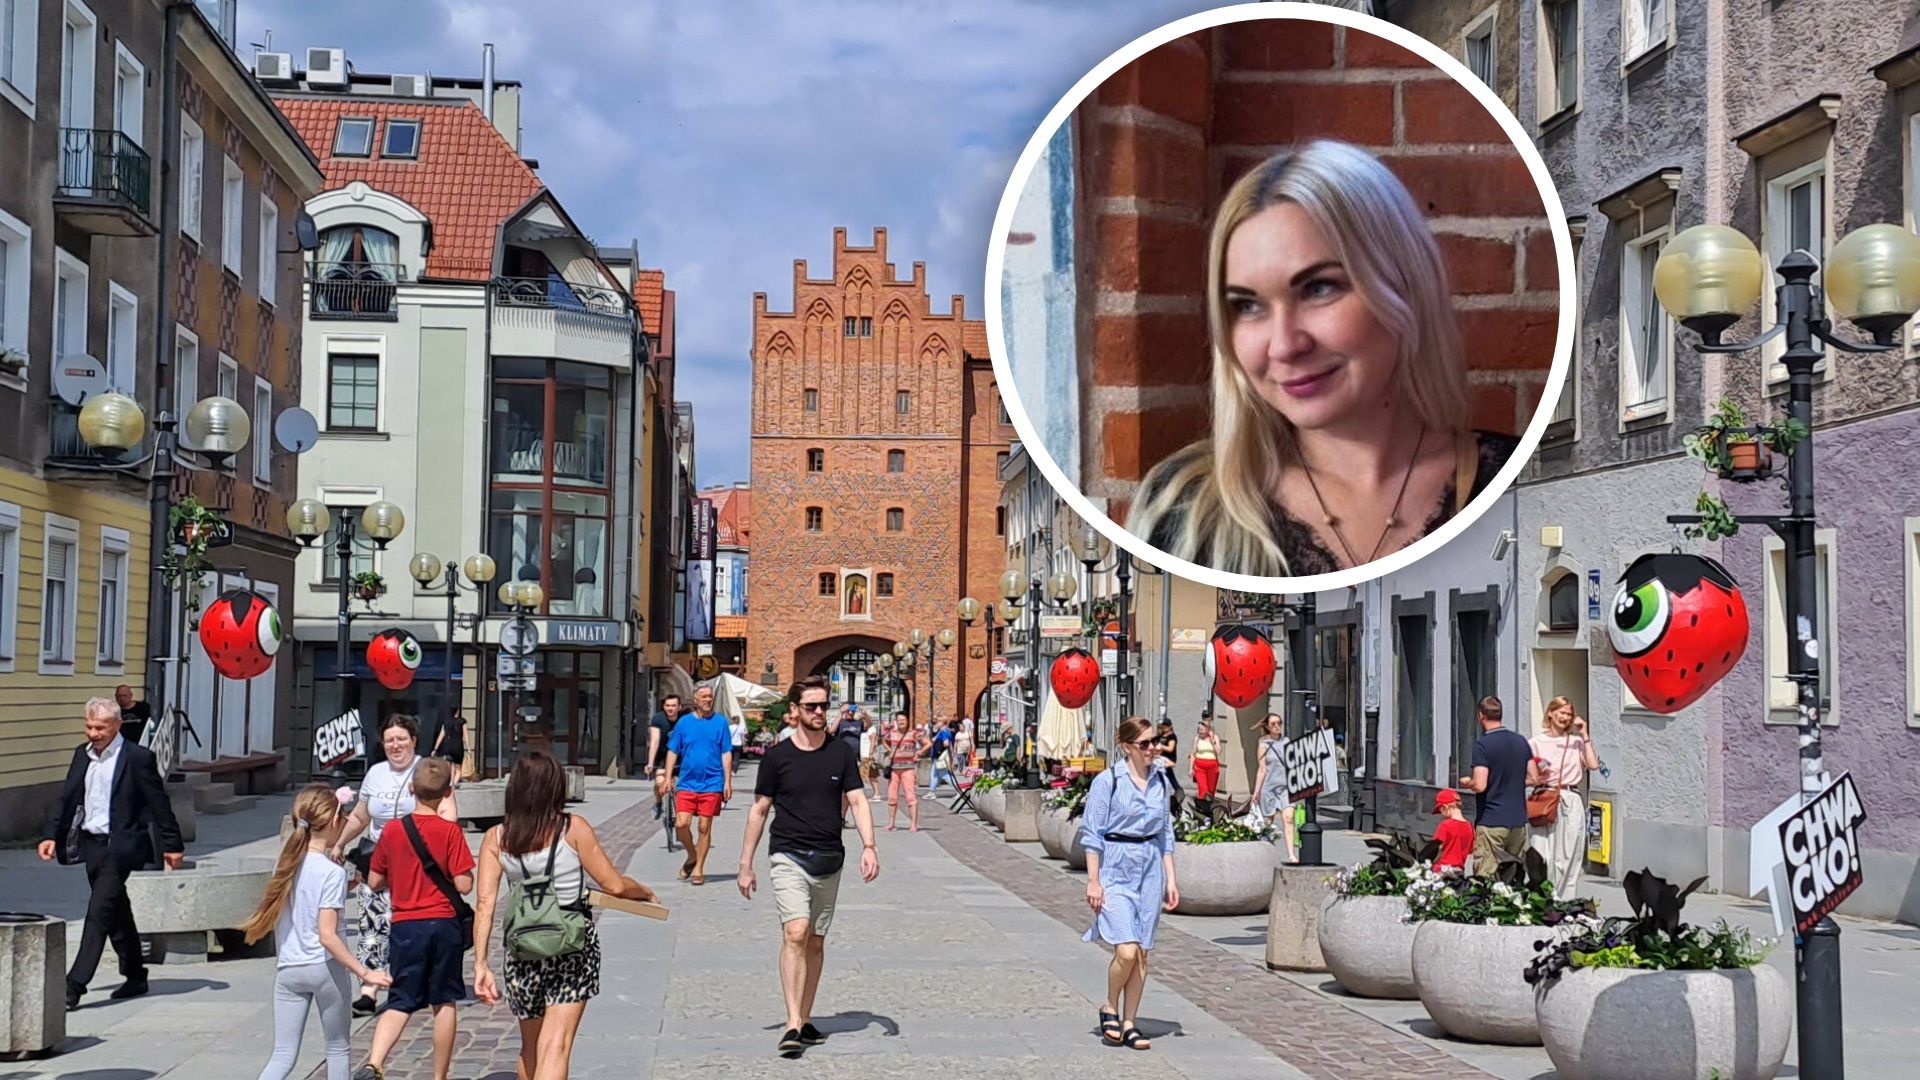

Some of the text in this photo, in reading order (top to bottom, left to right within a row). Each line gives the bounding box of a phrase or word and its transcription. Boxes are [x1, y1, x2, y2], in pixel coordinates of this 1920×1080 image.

[558, 624, 608, 641] KLIMATY
[316, 711, 358, 745] CHWA
[319, 731, 354, 763] CKO!
[1285, 730, 1328, 769] CHWA
[1288, 757, 1322, 794] CKO!
[1785, 777, 1862, 866] CHWA
[1793, 826, 1859, 912] CKO!
